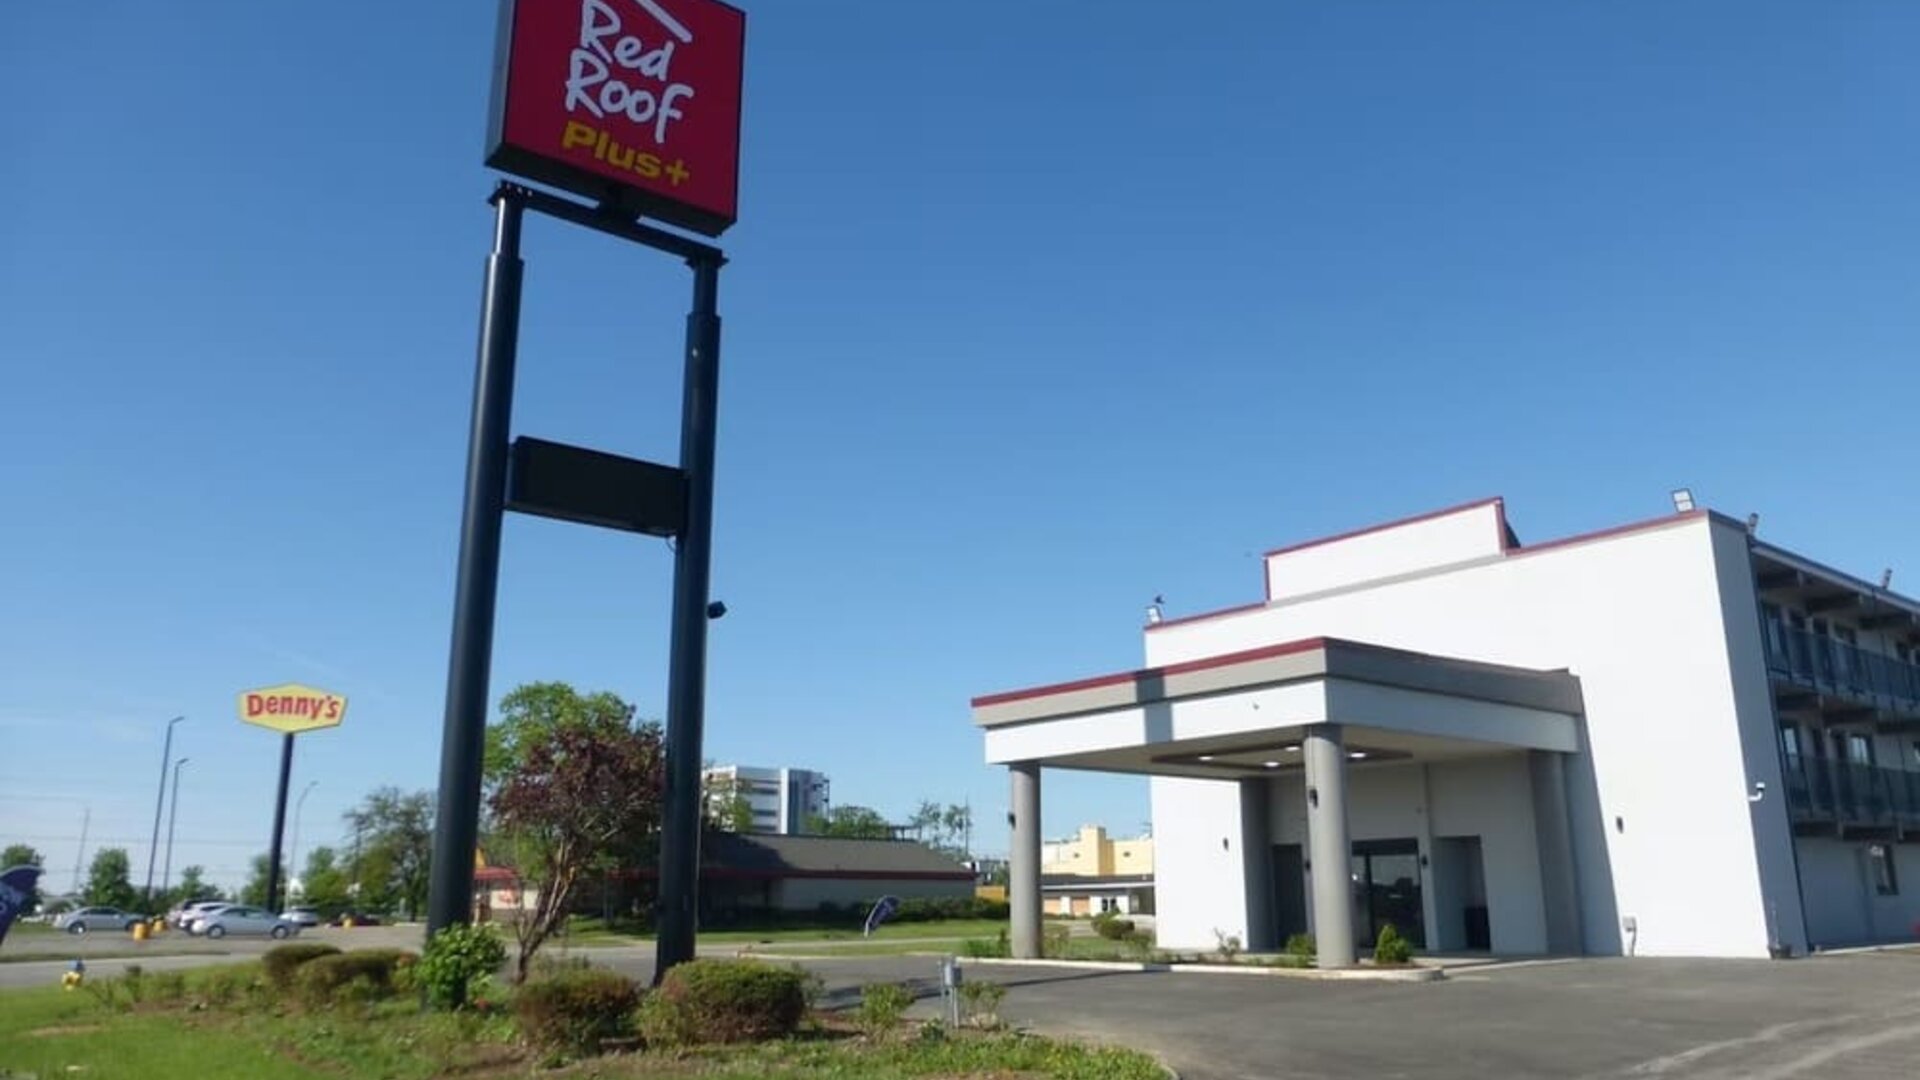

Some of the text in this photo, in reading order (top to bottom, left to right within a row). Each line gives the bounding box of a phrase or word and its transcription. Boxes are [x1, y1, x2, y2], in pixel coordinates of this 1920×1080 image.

[580, 0, 675, 81] Red
[565, 48, 695, 143] Roof
[562, 120, 690, 187] Plus+
[246, 694, 340, 720] Denny's
